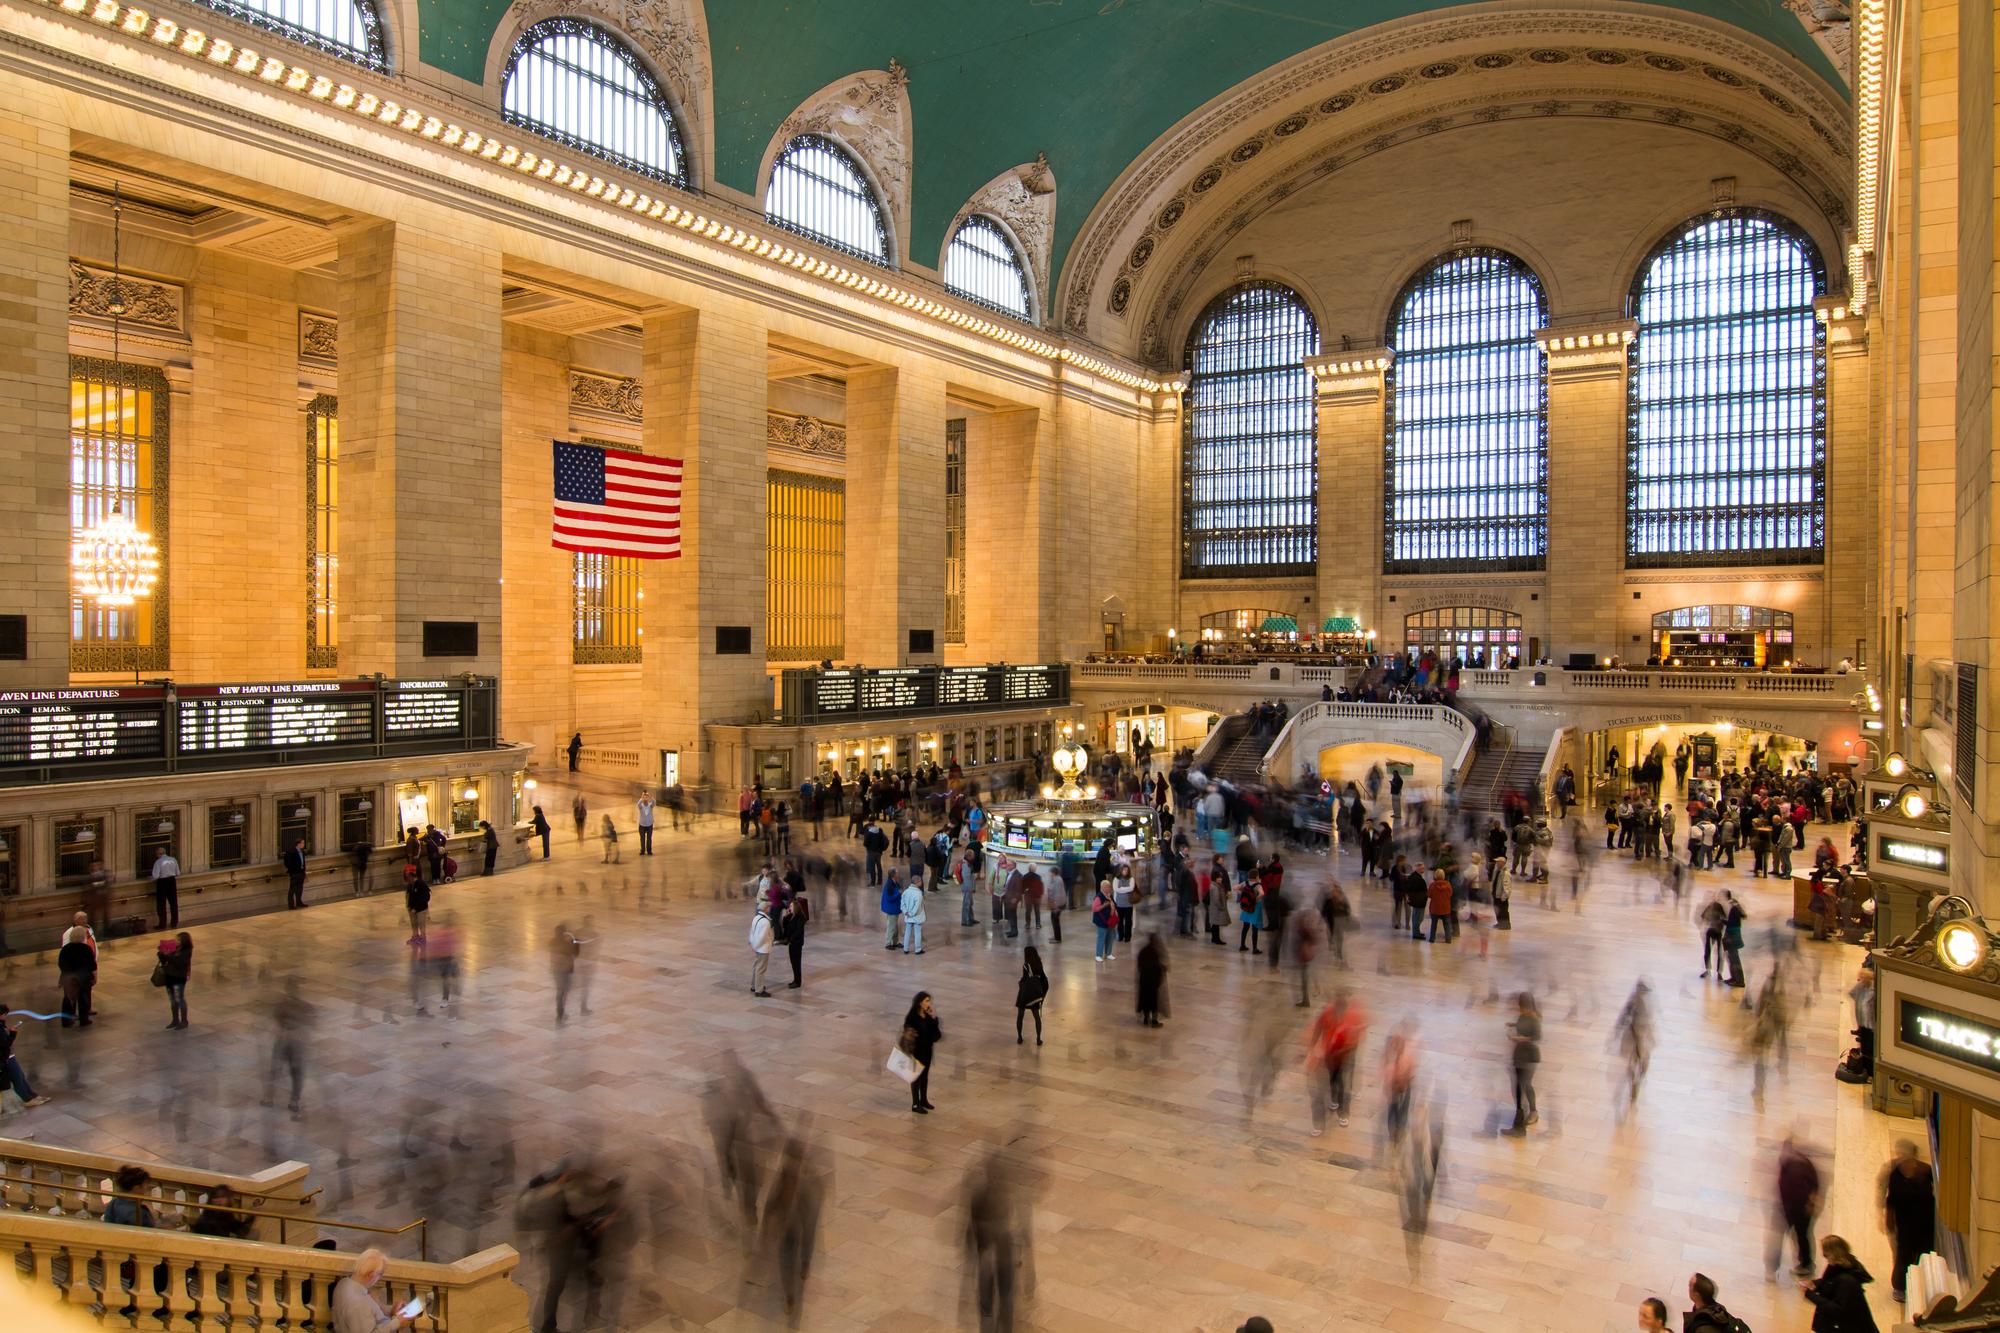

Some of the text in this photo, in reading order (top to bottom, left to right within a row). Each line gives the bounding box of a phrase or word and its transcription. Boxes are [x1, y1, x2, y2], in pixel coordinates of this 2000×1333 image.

[293, 684, 340, 692] DEPARTURES
[58, 690, 119, 699] DEPARTURES
[1607, 714, 1682, 726] TICKET MACHINES
[1712, 716, 1747, 724] TRCKS
[1888, 845, 1926, 862] TRACK
[1917, 1016, 1991, 1056] TRACK
